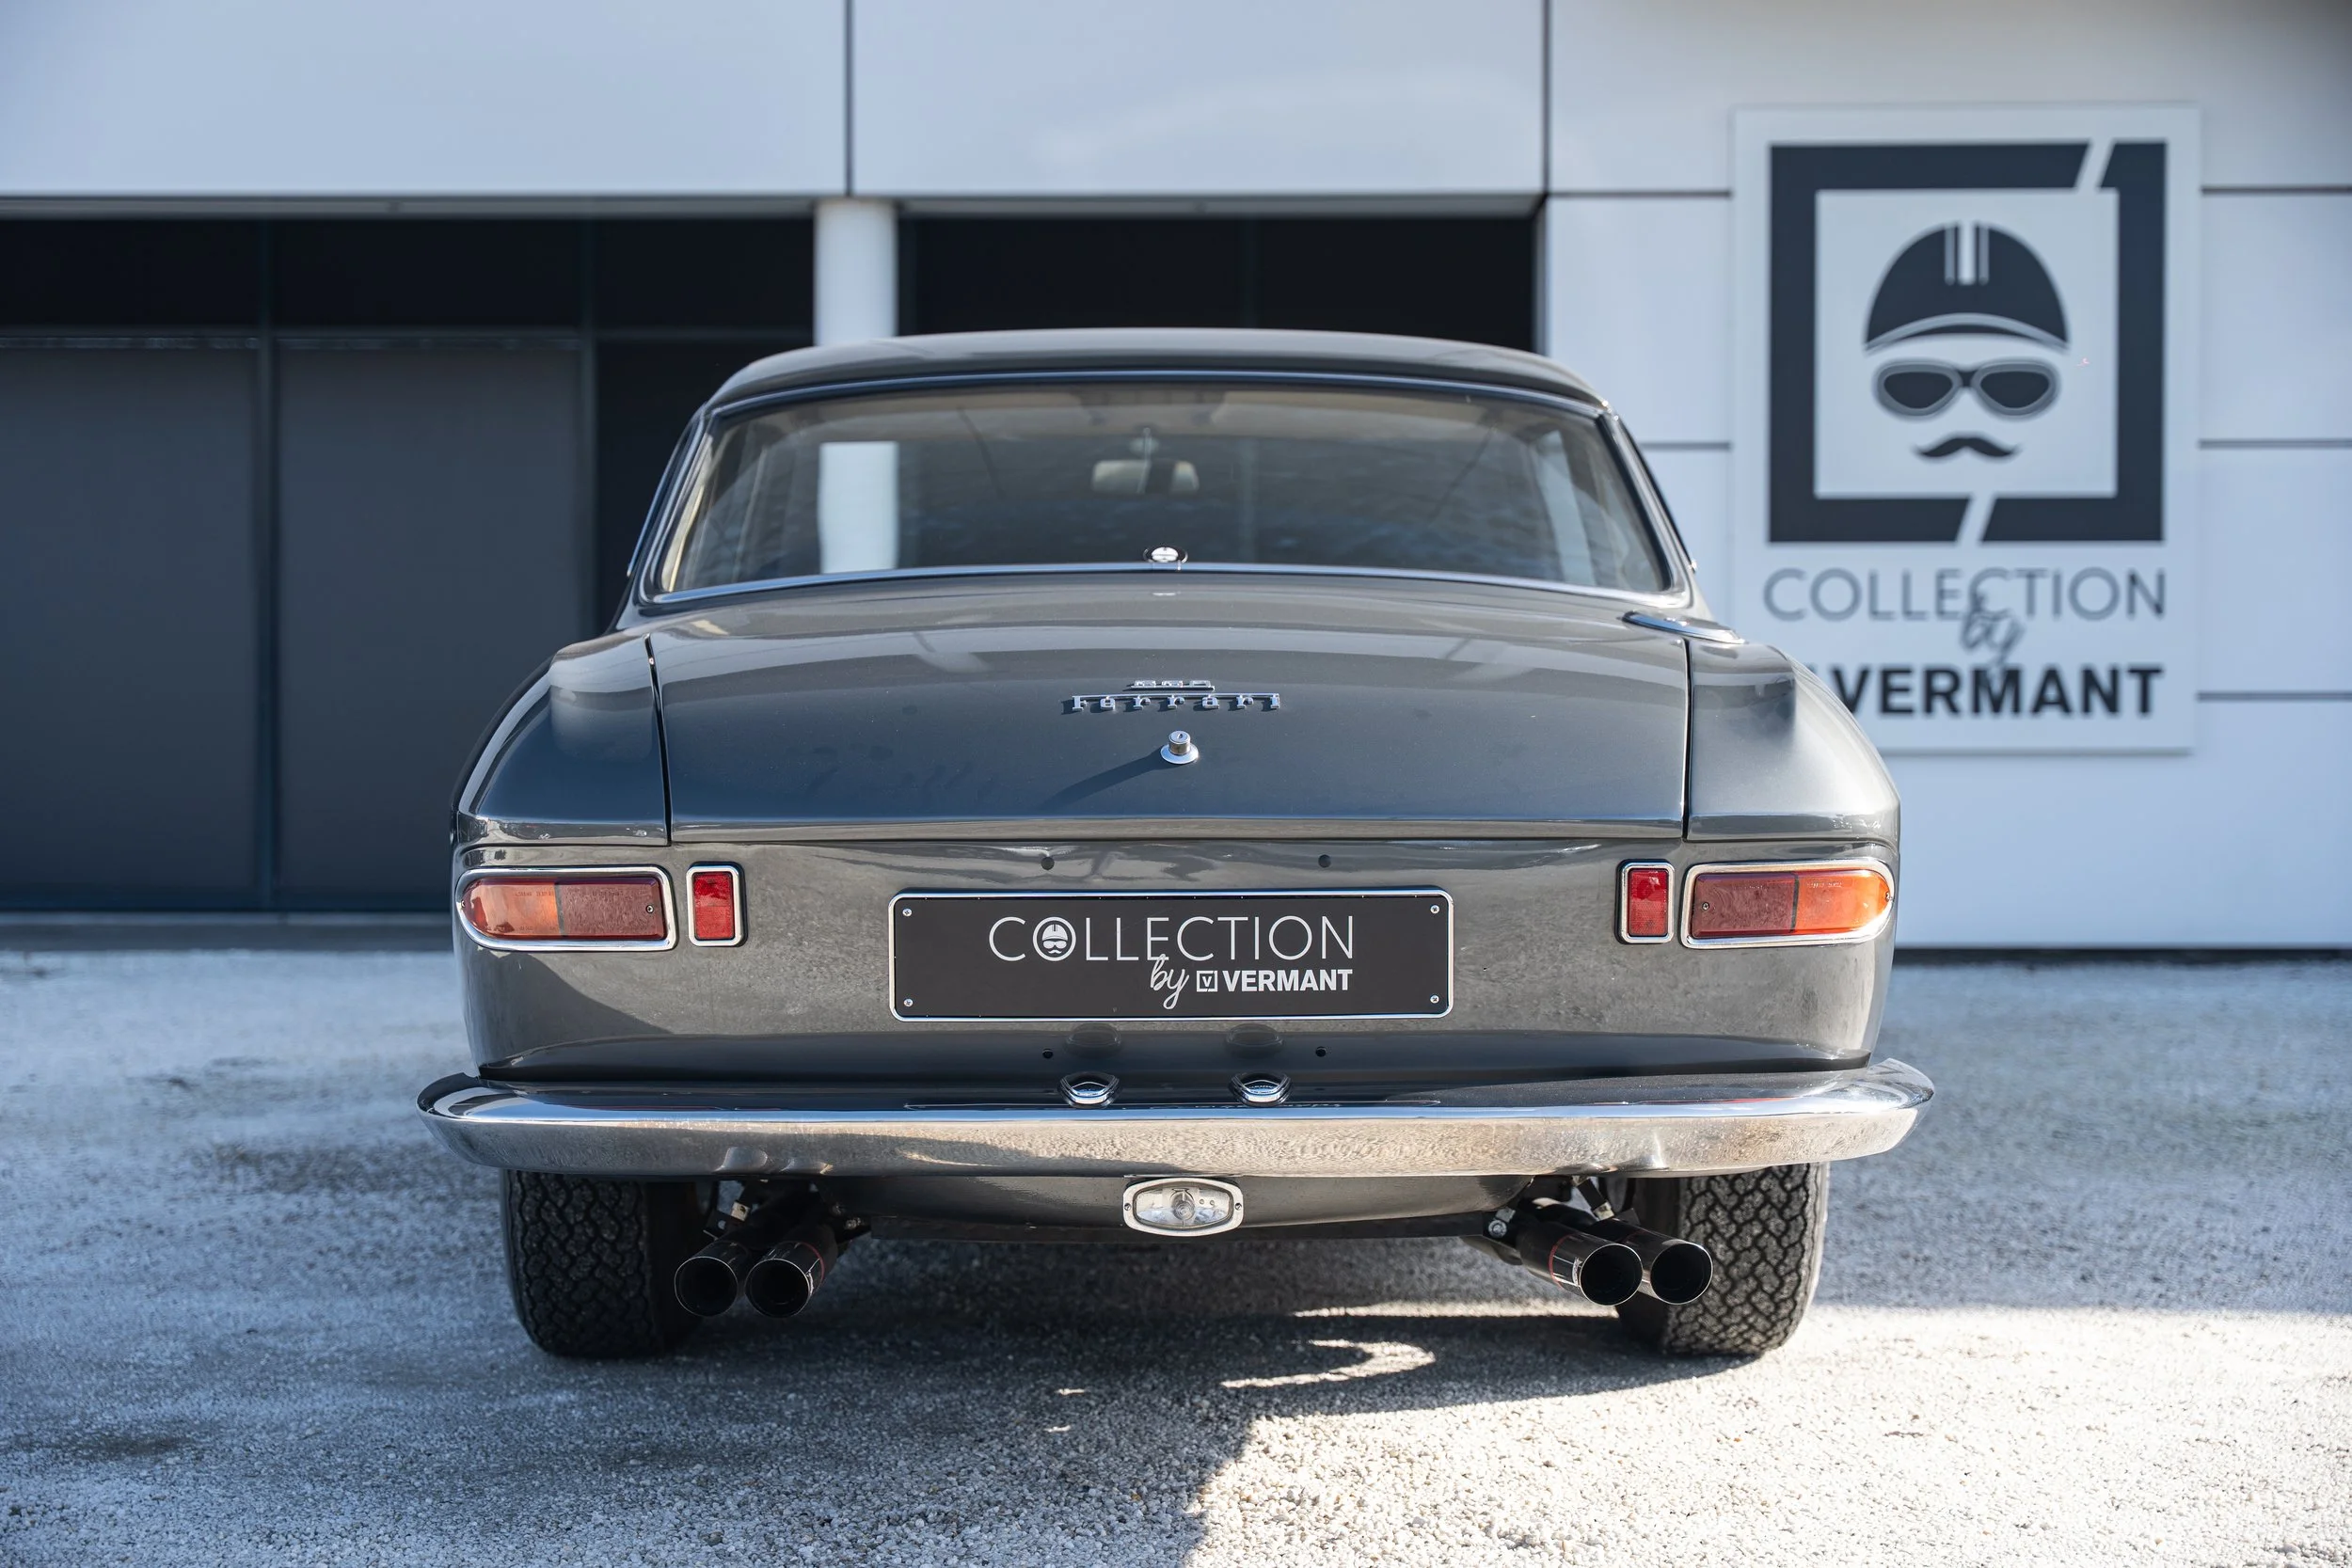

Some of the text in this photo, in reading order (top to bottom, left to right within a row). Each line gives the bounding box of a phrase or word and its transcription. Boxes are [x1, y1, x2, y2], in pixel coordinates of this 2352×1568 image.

[1763, 566, 2166, 621] COLLECTION
[1960, 590, 2026, 679] by
[1072, 692, 1280, 712] Ferrari
[1830, 664, 2164, 718] VERMANT
[989, 915, 1354, 961] COLLECTION
[1150, 953, 1190, 1010] by
[1222, 969, 1353, 992] VERMANT
